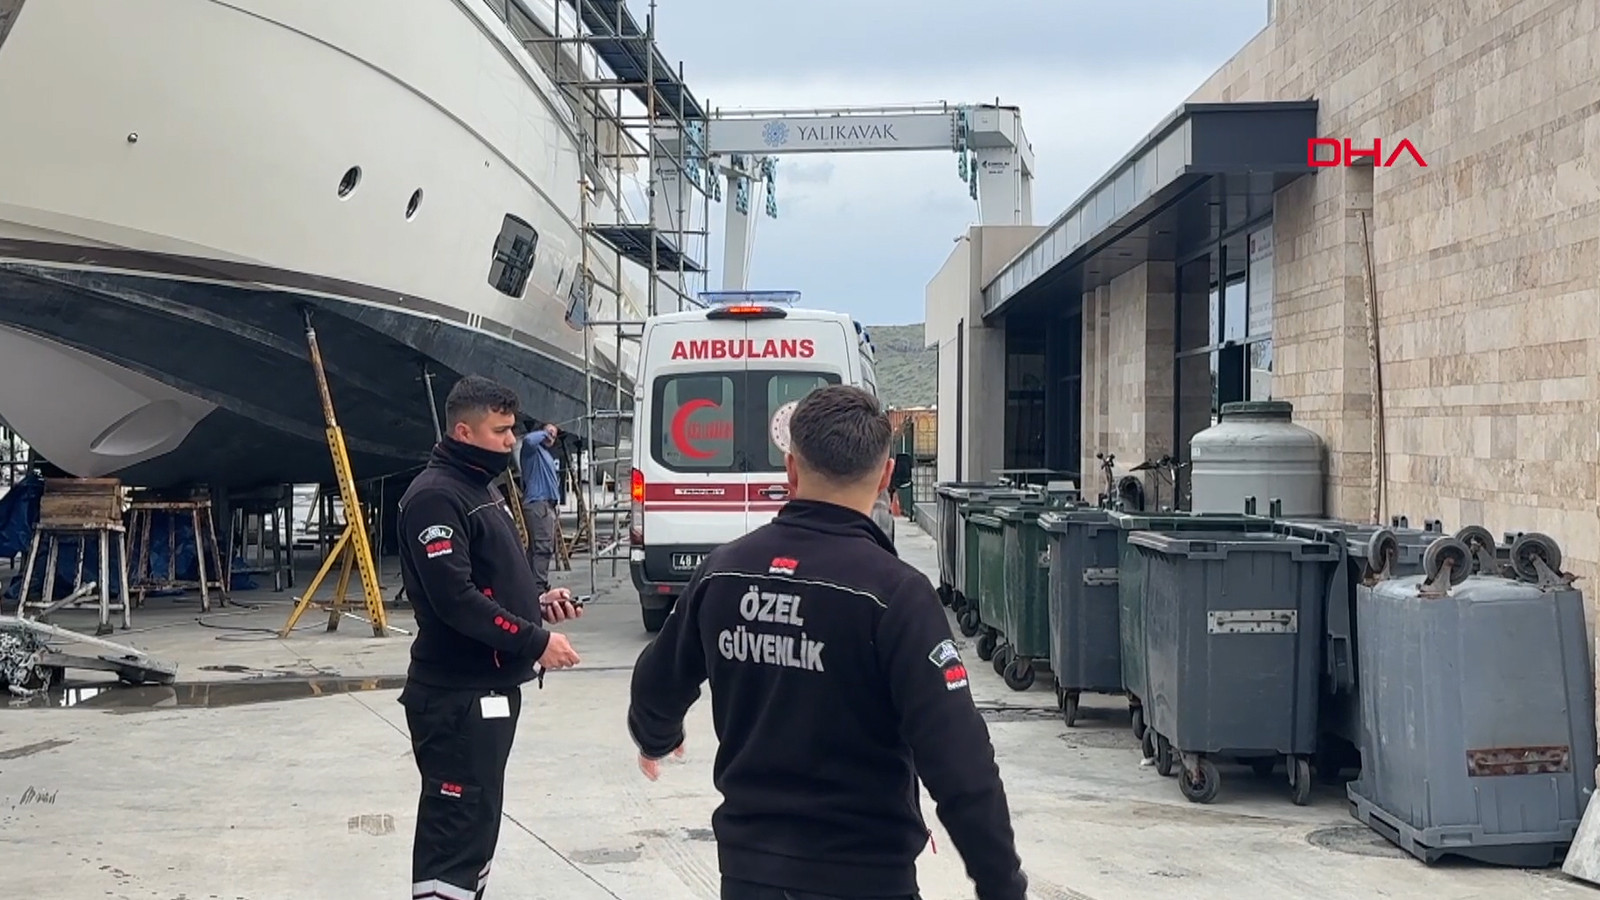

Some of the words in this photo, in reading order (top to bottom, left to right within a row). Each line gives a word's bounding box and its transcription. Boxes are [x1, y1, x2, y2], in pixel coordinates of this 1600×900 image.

[797, 123, 898, 141] YALIKAVAK
[671, 339, 815, 360] AMBULANS
[740, 585, 804, 626] ÖZEL
[718, 625, 824, 672] GÜVENLİK
